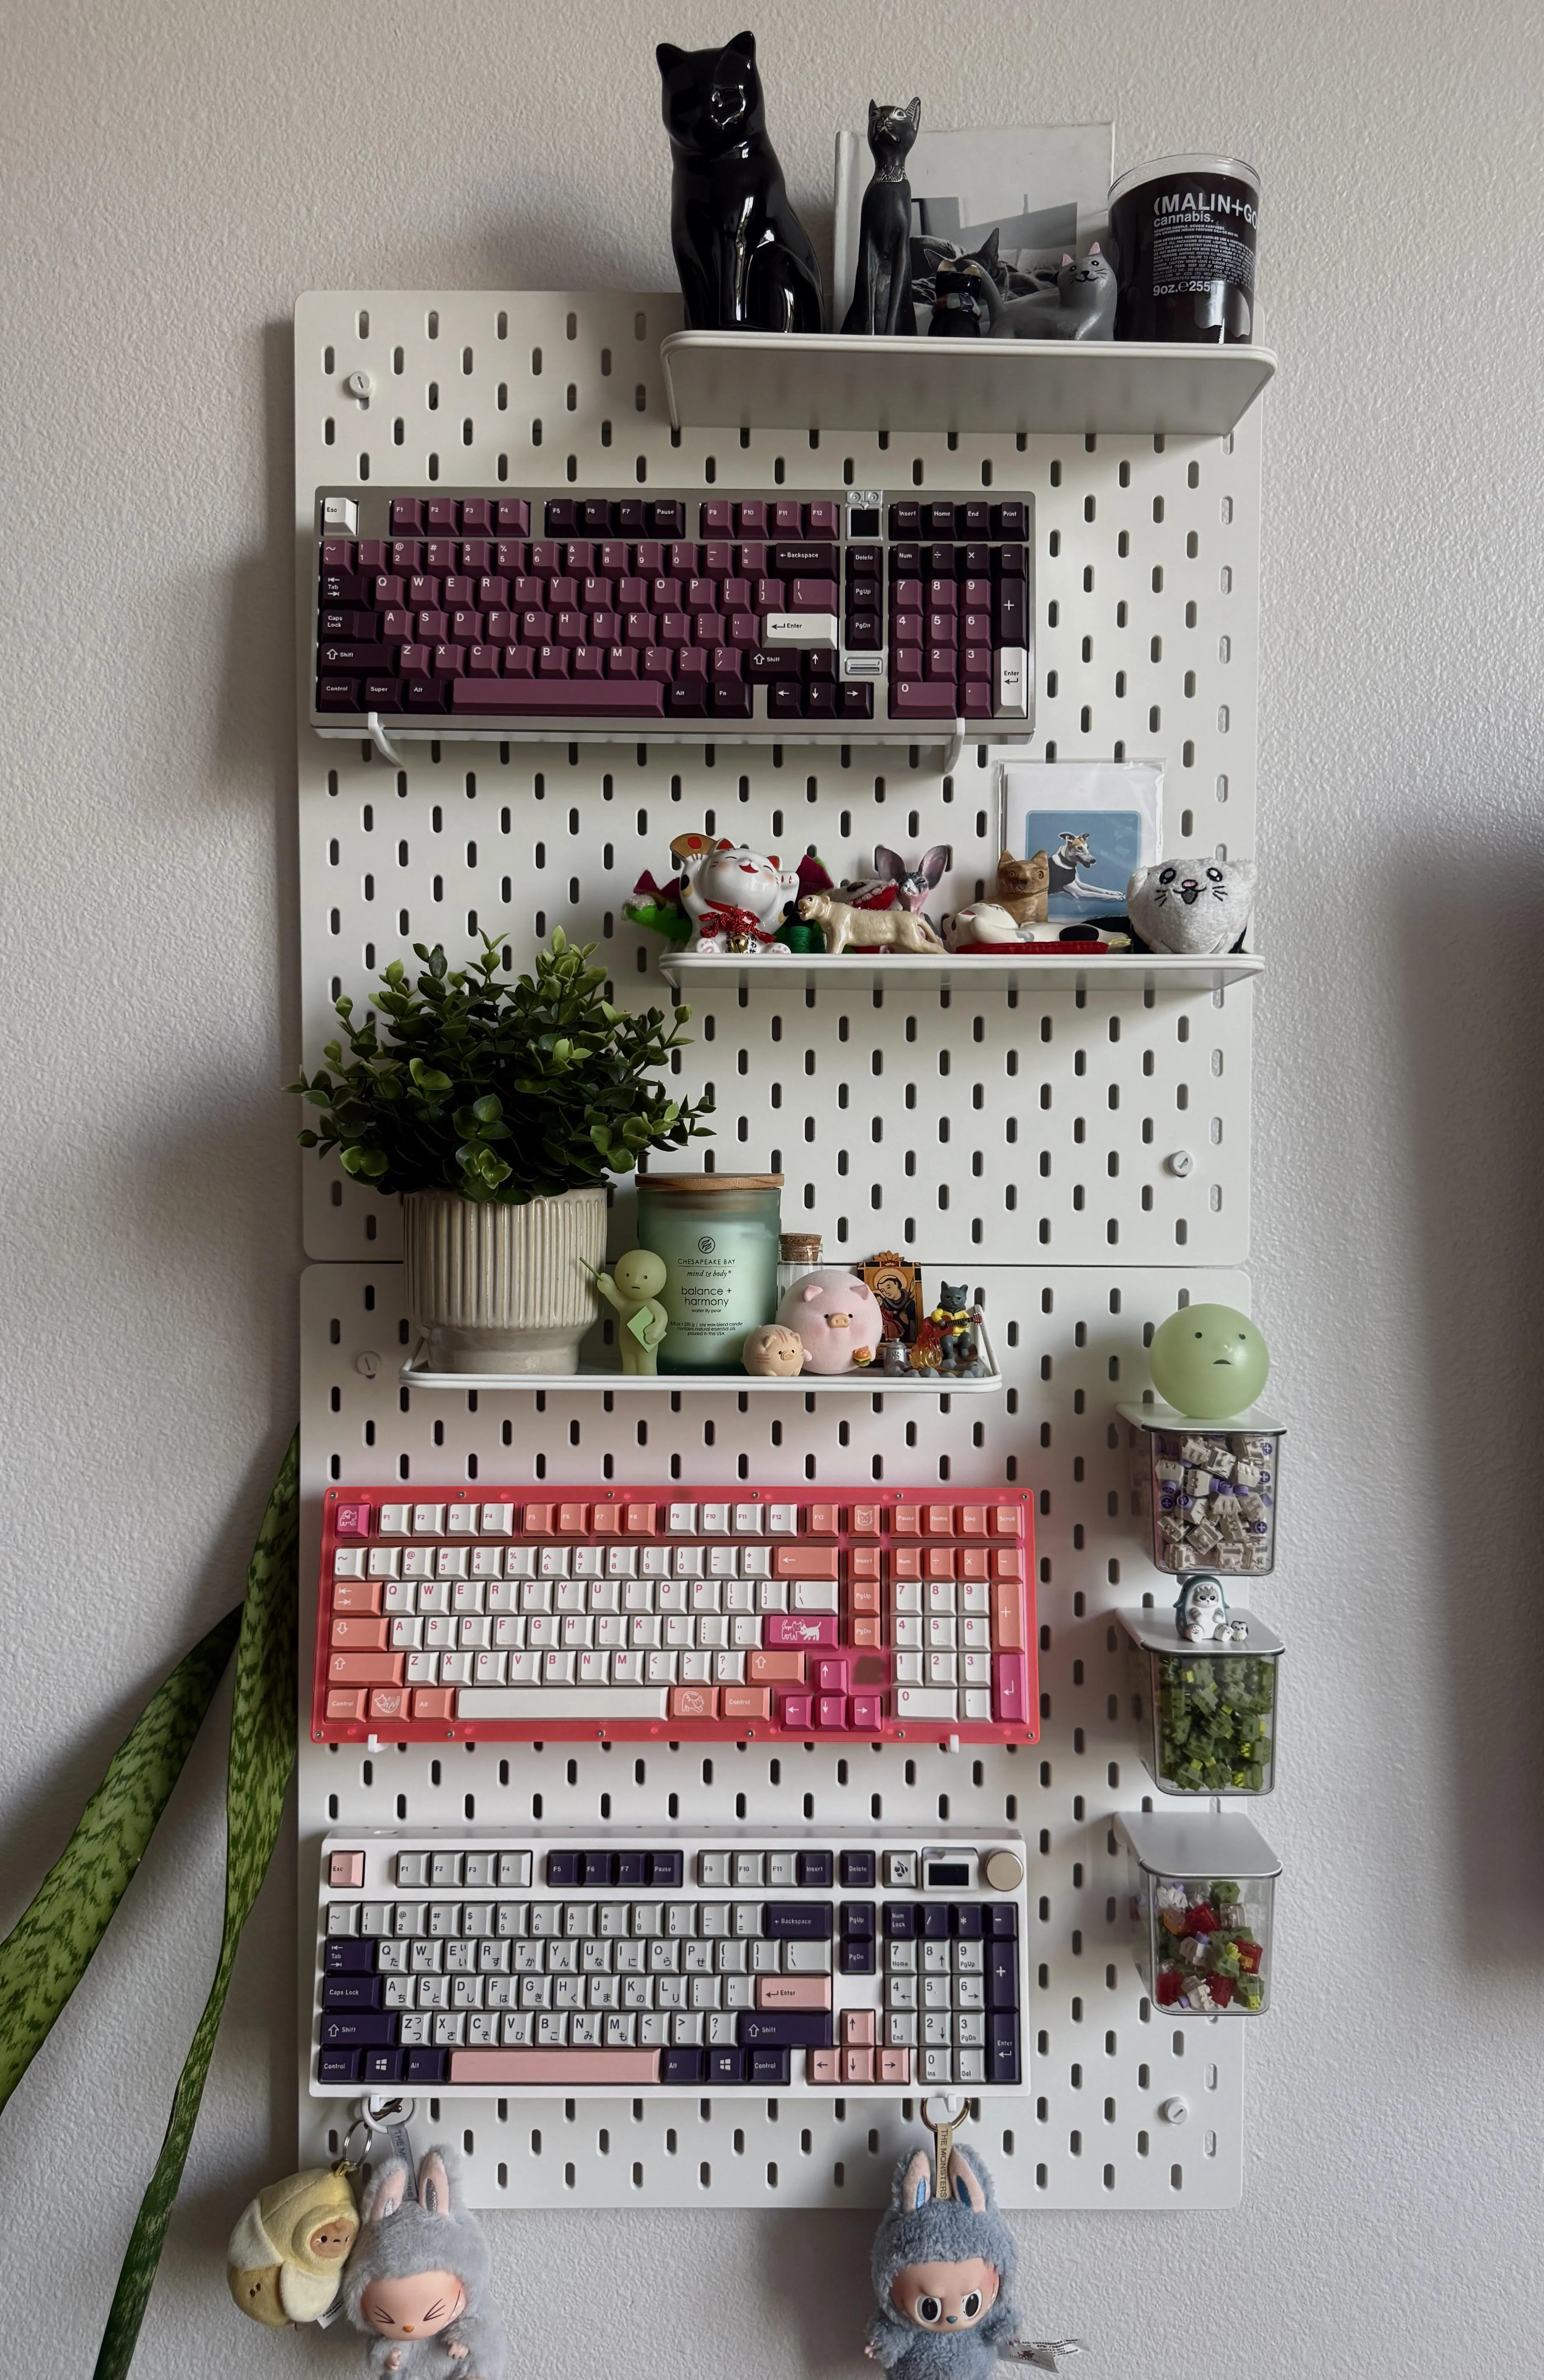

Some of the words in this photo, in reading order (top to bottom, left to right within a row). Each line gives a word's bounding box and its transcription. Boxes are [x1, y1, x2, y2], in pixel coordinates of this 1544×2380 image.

[1154, 210, 1214, 227] cannabis.
[378, 578, 387, 587] Q
[448, 578, 454, 587] E
[483, 579, 490, 587] R
[518, 579, 525, 587] T
[553, 579, 559, 588] Y
[657, 580, 665, 589] O
[691, 581, 698, 589] P
[681, 1286, 723, 1295] balance
[685, 1297, 729, 1307] harmony
